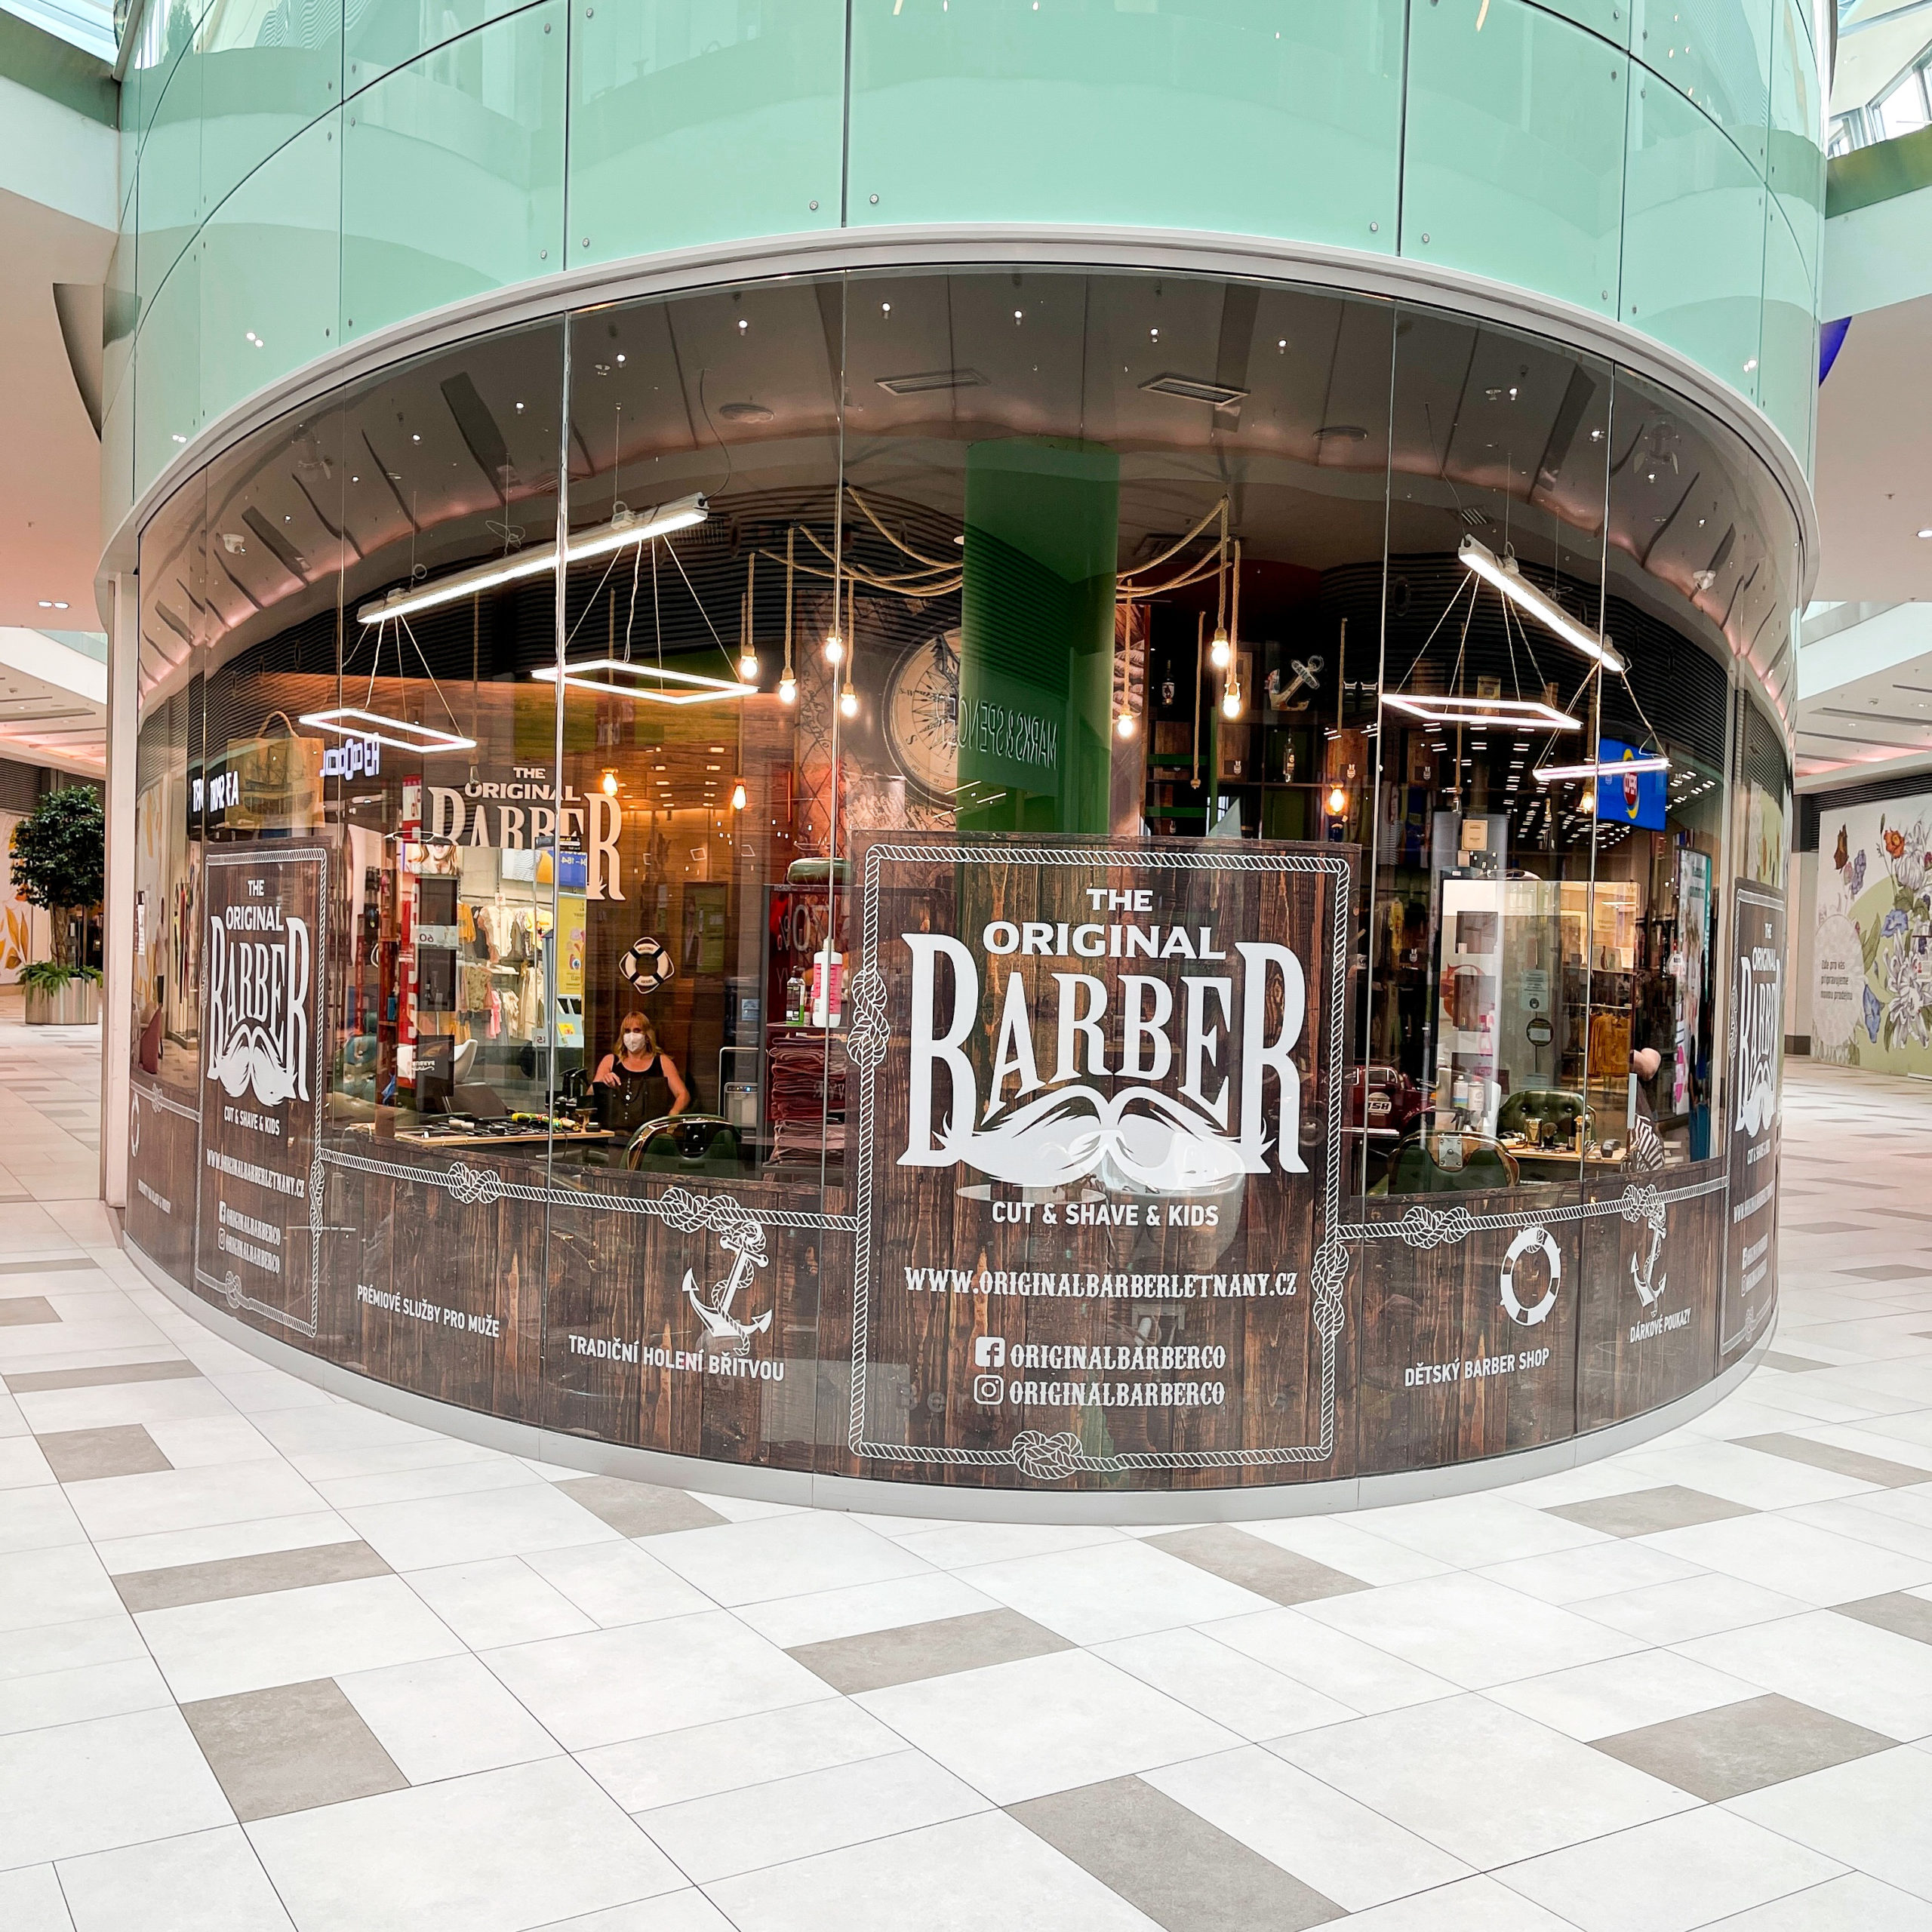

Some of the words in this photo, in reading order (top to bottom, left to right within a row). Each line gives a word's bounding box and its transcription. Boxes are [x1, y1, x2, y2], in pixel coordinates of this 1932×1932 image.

[512, 767, 546, 780] THE
[464, 782, 581, 801] ORIGINAL
[248, 879, 264, 897] THE
[1086, 888, 1154, 912] THE
[226, 906, 285, 932] ORIGINAL
[983, 921, 1226, 960] ORIGINAL
[207, 915, 310, 1102] BARBER
[895, 931, 1310, 1174] BARBER
[223, 1105, 235, 1122] CUT
[239, 1109, 258, 1131] SHAVE
[259, 1115, 263, 1131] &
[264, 1117, 280, 1136] KIDS
[992, 1201, 1035, 1224] CUT
[1042, 1204, 1058, 1226] &
[1066, 1203, 1139, 1226] SHAVE
[1146, 1204, 1161, 1226] &
[1168, 1204, 1220, 1227] KIDS
[904, 1266, 1298, 1299] WWW.ORIGINALBARBERLETNANY.CZ
[357, 1283, 401, 1313] PRÉMIOVÉ
[402, 1297, 441, 1323] SLUŽBY
[443, 1308, 466, 1330] PRO
[468, 1313, 500, 1338] MUŽE
[1630, 1313, 1664, 1343] DÁRKOVÉ
[1663, 1307, 1691, 1333] POUKAZY
[568, 1334, 640, 1363] TRADIČNÍ
[643, 1346, 705, 1372] HOLENÍ
[709, 1351, 785, 1382] BŘITVOU
[1010, 1343, 1227, 1371] ORIGINALBARBERCO
[1404, 1358, 1461, 1387] DĚTSKÝ
[1464, 1354, 1515, 1379] BARBER
[1518, 1347, 1550, 1370] SHOP
[1009, 1380, 1226, 1407] ORIGINALBARBERCO
